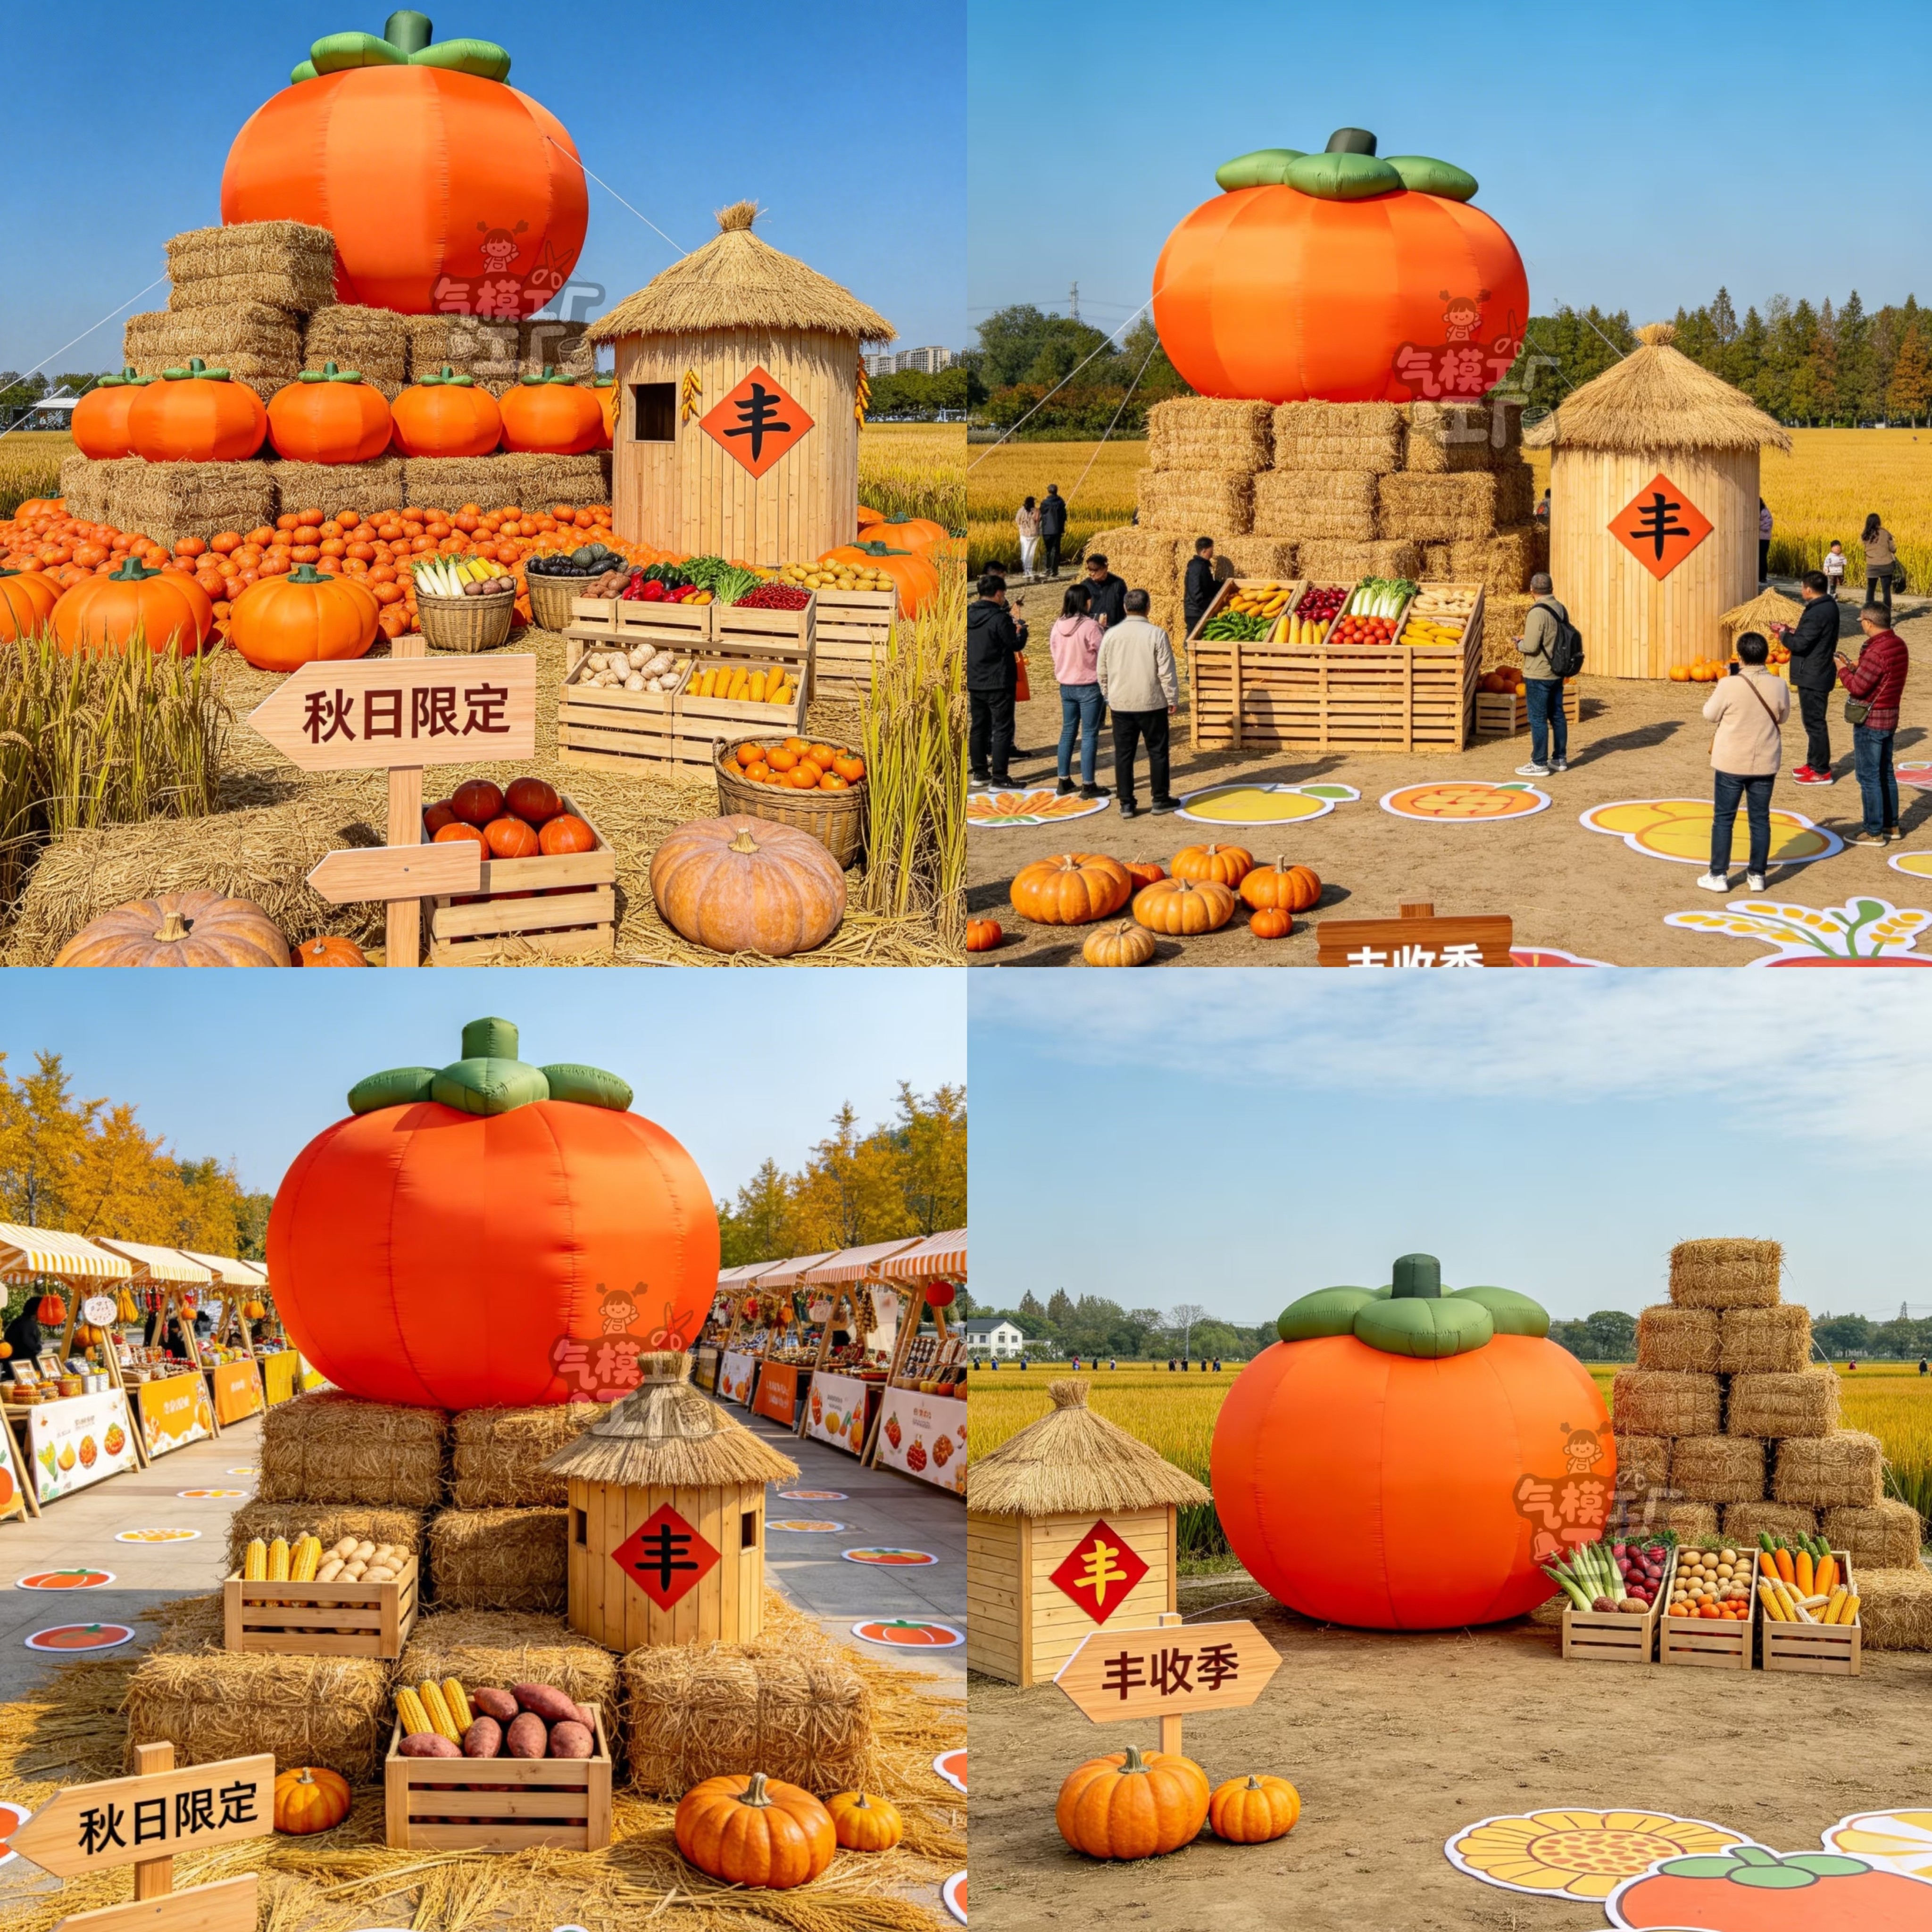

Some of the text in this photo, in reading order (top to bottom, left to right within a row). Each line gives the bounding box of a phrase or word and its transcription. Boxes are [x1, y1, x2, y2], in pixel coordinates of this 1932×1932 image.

[723, 383, 791, 462] 丰
[1630, 492, 1690, 562] 丰
[302, 683, 511, 744] 秋日限定
[634, 1524, 699, 1592] 丰
[1073, 1540, 1127, 1607] 丰
[1101, 1642, 1240, 1700] 丰收季
[78, 1781, 258, 1856] 秋日限定
